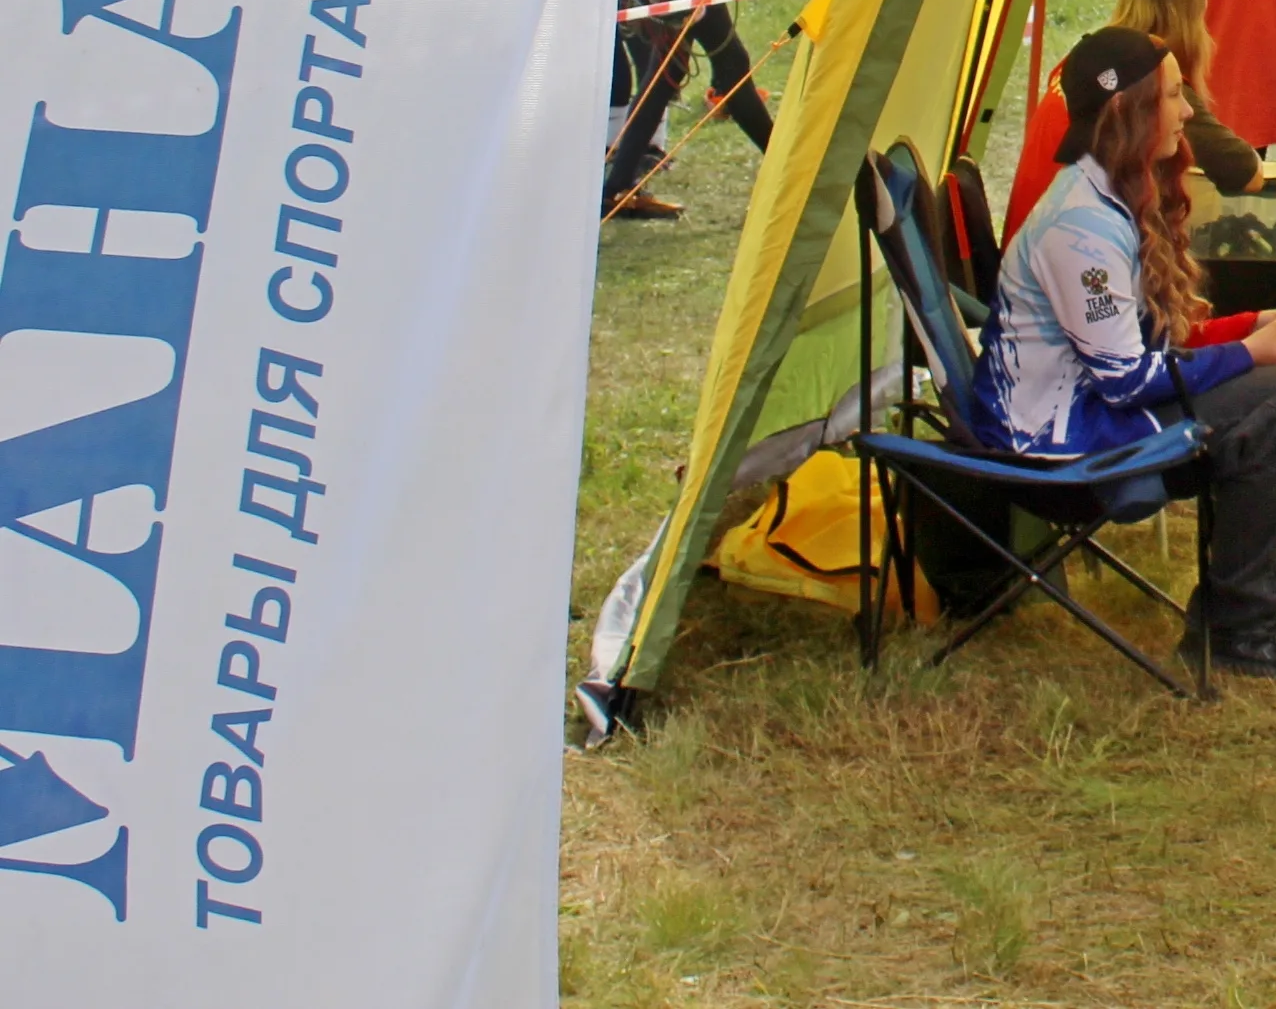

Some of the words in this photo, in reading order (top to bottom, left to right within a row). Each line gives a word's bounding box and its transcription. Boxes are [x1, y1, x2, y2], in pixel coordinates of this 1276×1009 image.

[1085, 305, 1120, 324] RUSSIA
[1086, 294, 1113, 311] TEAM
[239, 348, 326, 545] ДЛЯ
[195, 555, 297, 929] ТОВАРЫ
